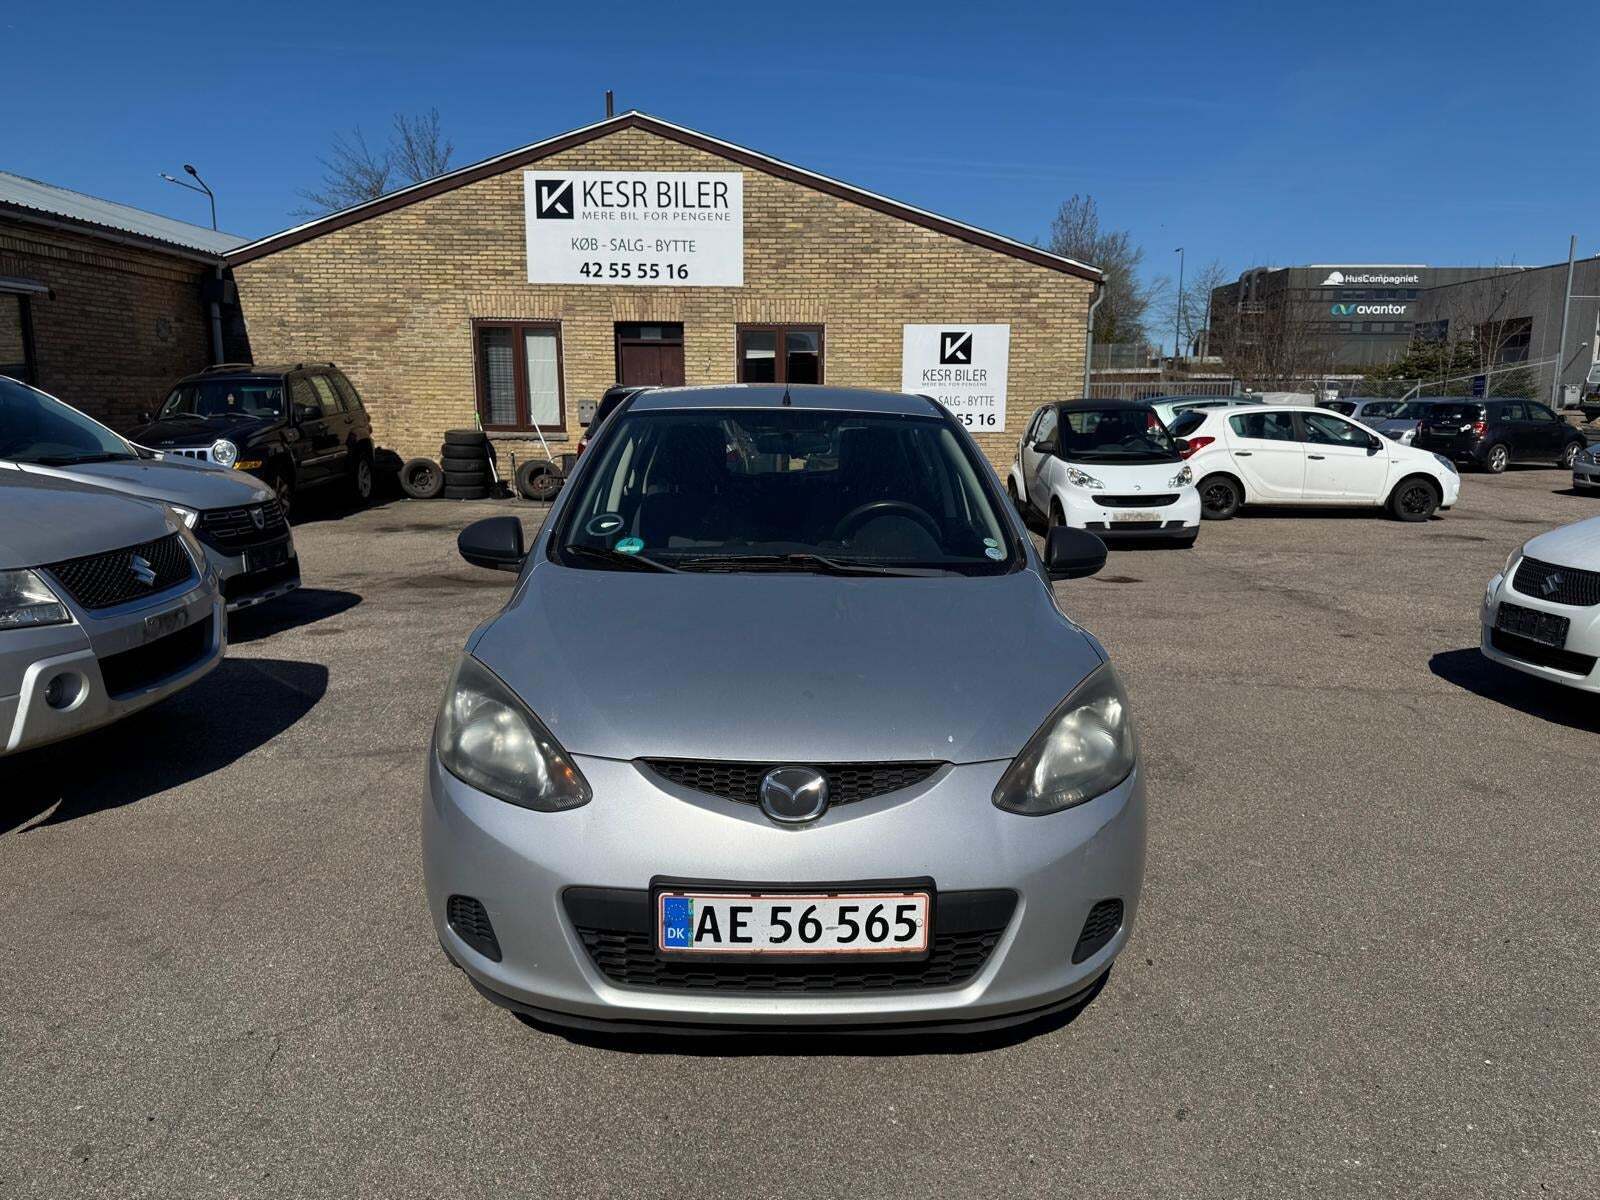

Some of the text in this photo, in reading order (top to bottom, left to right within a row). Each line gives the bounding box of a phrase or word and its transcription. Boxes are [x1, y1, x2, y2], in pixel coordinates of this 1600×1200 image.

[583, 180, 729, 209] KESR BILER
[582, 211, 731, 221] MERE BIL FOR PENGENE
[571, 238, 598, 251] KØB
[610, 238, 644, 252] SALG
[655, 240, 696, 253] BYTTE
[580, 262, 689, 279] 42 55 55 16
[1345, 274, 1419, 284] HusCompagniet
[1356, 304, 1406, 314] avantor
[922, 369, 987, 381] KESR BILER
[938, 396, 961, 406] SALG
[968, 395, 995, 406] BYTTE
[978, 413, 996, 425] 16
[694, 903, 918, 944] AE 56 565
[667, 927, 685, 939] DK
